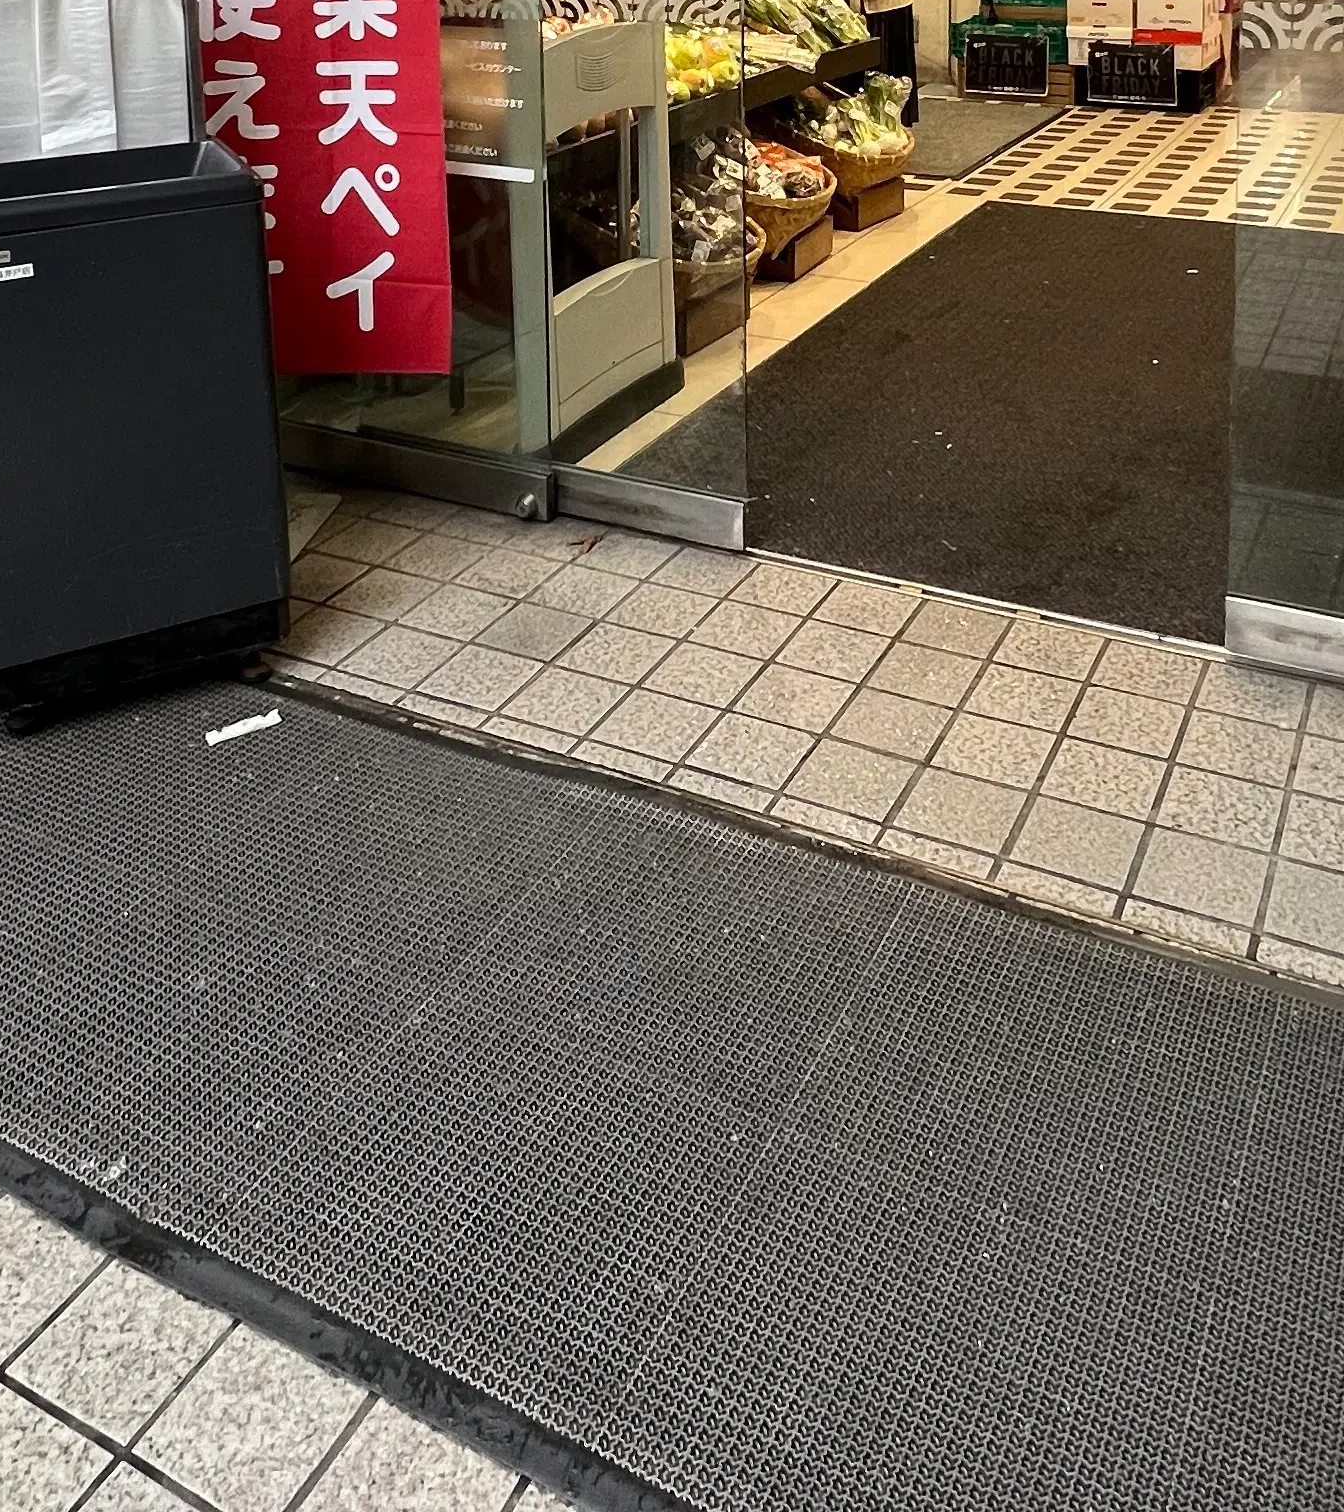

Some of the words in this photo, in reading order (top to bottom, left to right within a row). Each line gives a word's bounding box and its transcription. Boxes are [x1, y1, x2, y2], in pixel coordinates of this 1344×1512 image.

[978, 47, 1035, 65] BLACK
[1101, 56, 1160, 76] BLACK
[978, 67, 1035, 87] FRIDAY
[1101, 76, 1160, 95] FRIDAY
